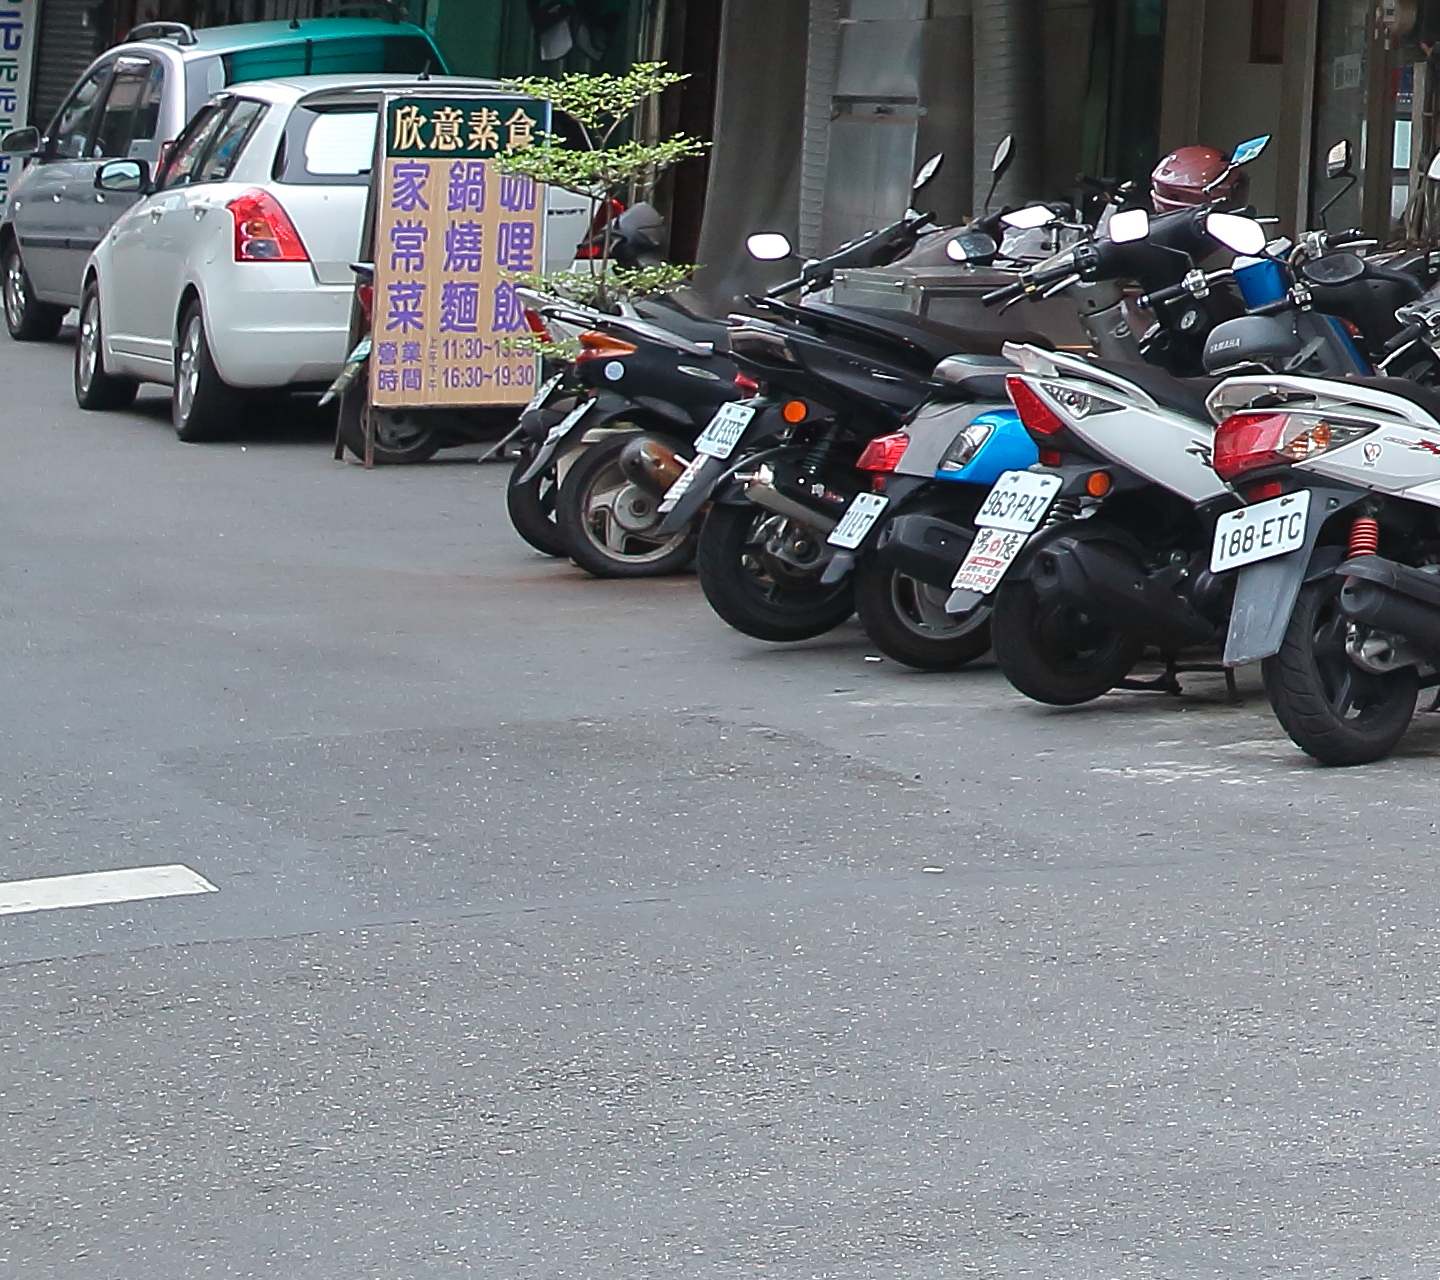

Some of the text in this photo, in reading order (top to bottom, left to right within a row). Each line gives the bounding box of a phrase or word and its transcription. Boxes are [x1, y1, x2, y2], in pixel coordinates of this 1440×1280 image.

[392, 105, 538, 152] 欣意素食
[385, 159, 431, 334] 家常菜
[439, 159, 486, 334] 鍋燒麵
[1209, 338, 1240, 353] YAMAHA
[442, 366, 534, 389] 16:30~19:30
